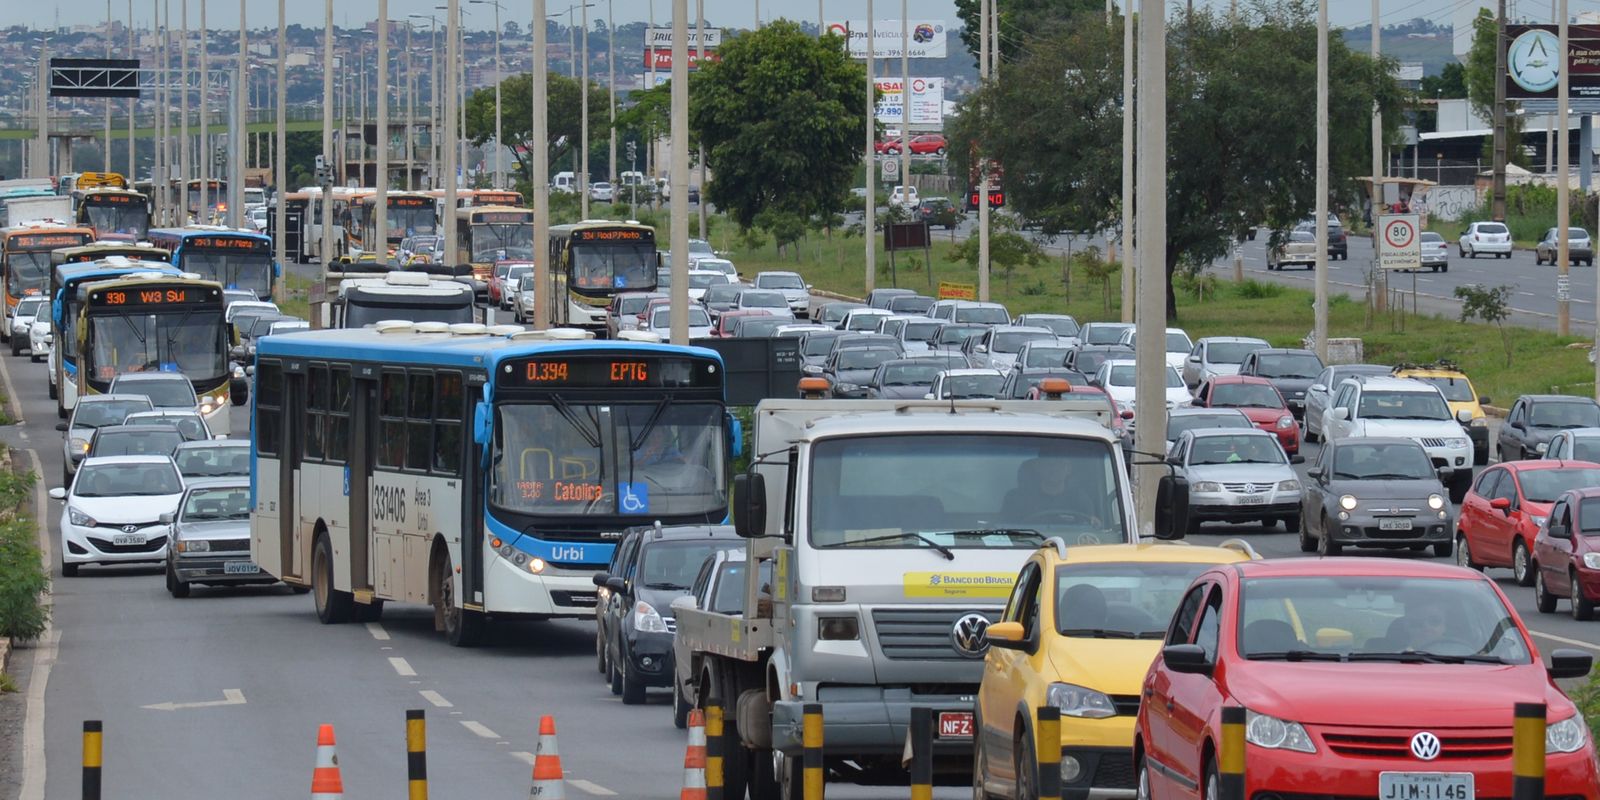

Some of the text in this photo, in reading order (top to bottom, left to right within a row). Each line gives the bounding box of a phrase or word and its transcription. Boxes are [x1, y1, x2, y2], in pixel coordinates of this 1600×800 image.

[1393, 226, 1407, 237] 80
[107, 289, 185, 304] 930 W3 Sul
[527, 363, 647, 381] 0.394 EPTG
[427, 488, 432, 507] 3
[555, 480, 602, 501] Catolica
[374, 485, 406, 523] 331406
[417, 511, 429, 531] Urbi
[552, 546, 584, 560] Urbi
[943, 575, 972, 584] BANCO
[985, 575, 1013, 584] BRASIL
